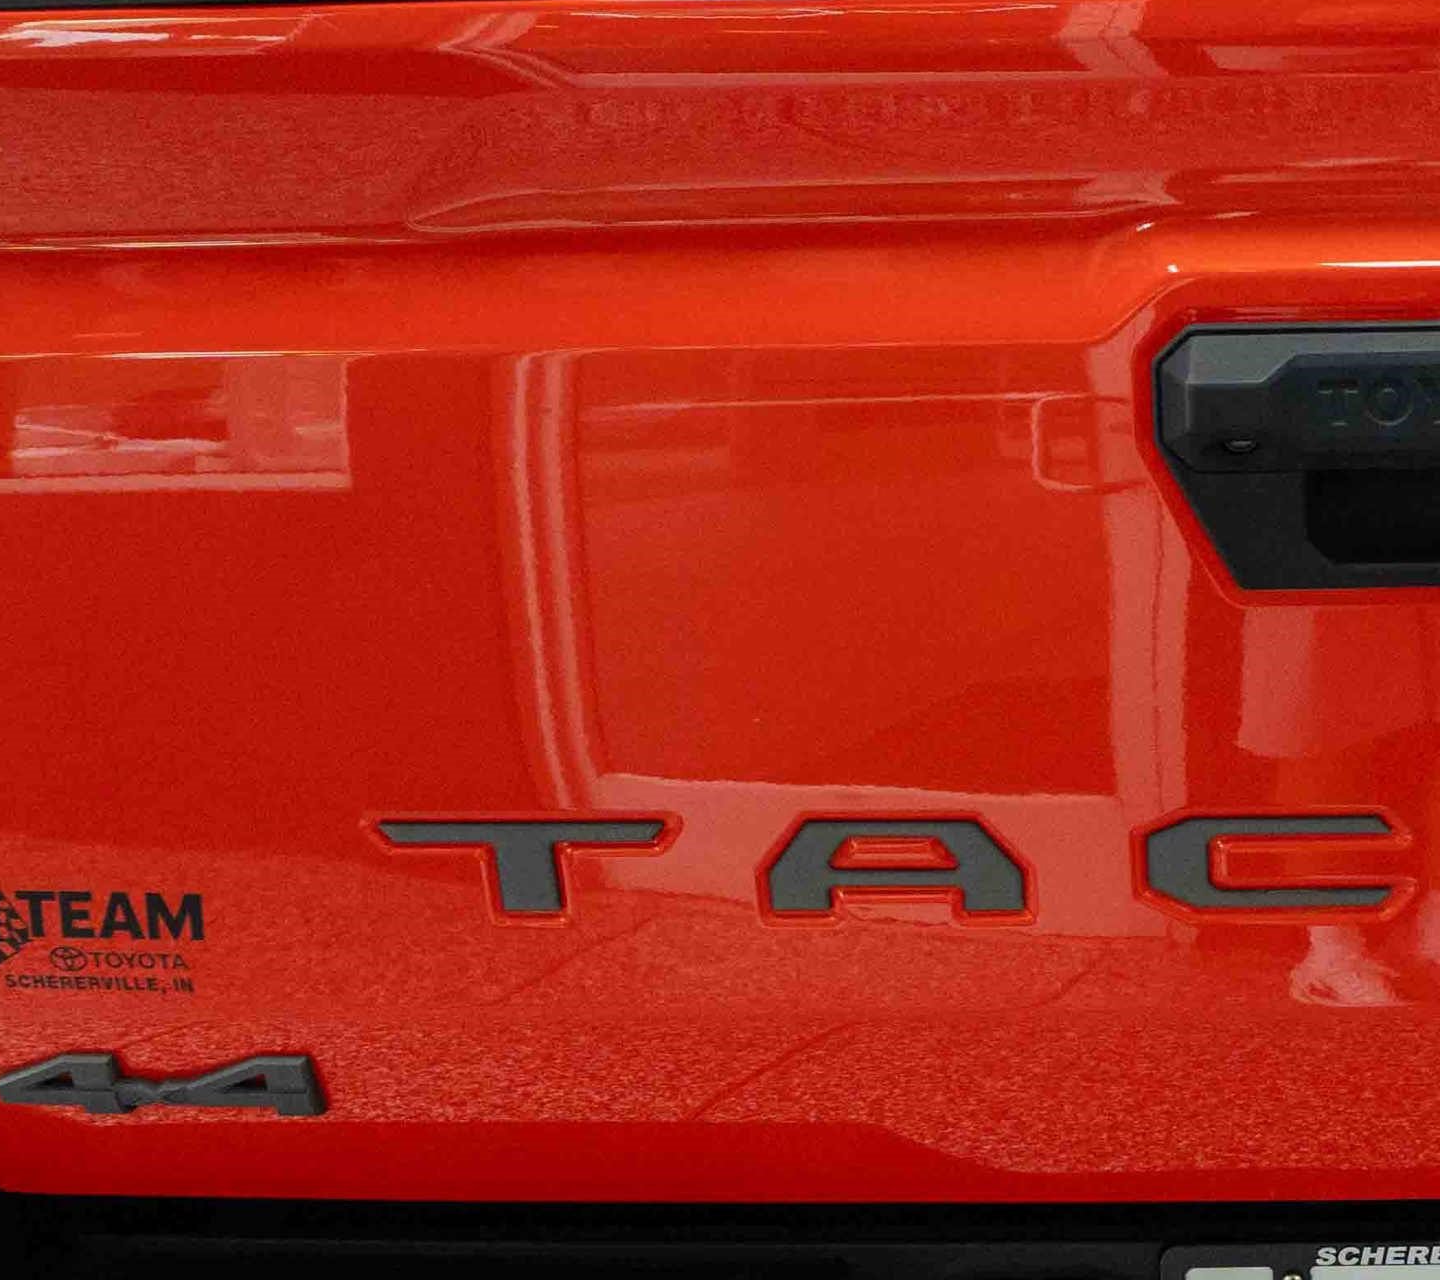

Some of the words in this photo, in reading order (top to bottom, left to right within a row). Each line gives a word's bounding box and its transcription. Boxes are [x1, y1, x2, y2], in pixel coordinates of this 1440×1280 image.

[15, 890, 205, 941] TEAM
[90, 951, 191, 970] TOYOTA
[4, 975, 168, 995] SCHERERVILLE,
[173, 977, 195, 993] IN
